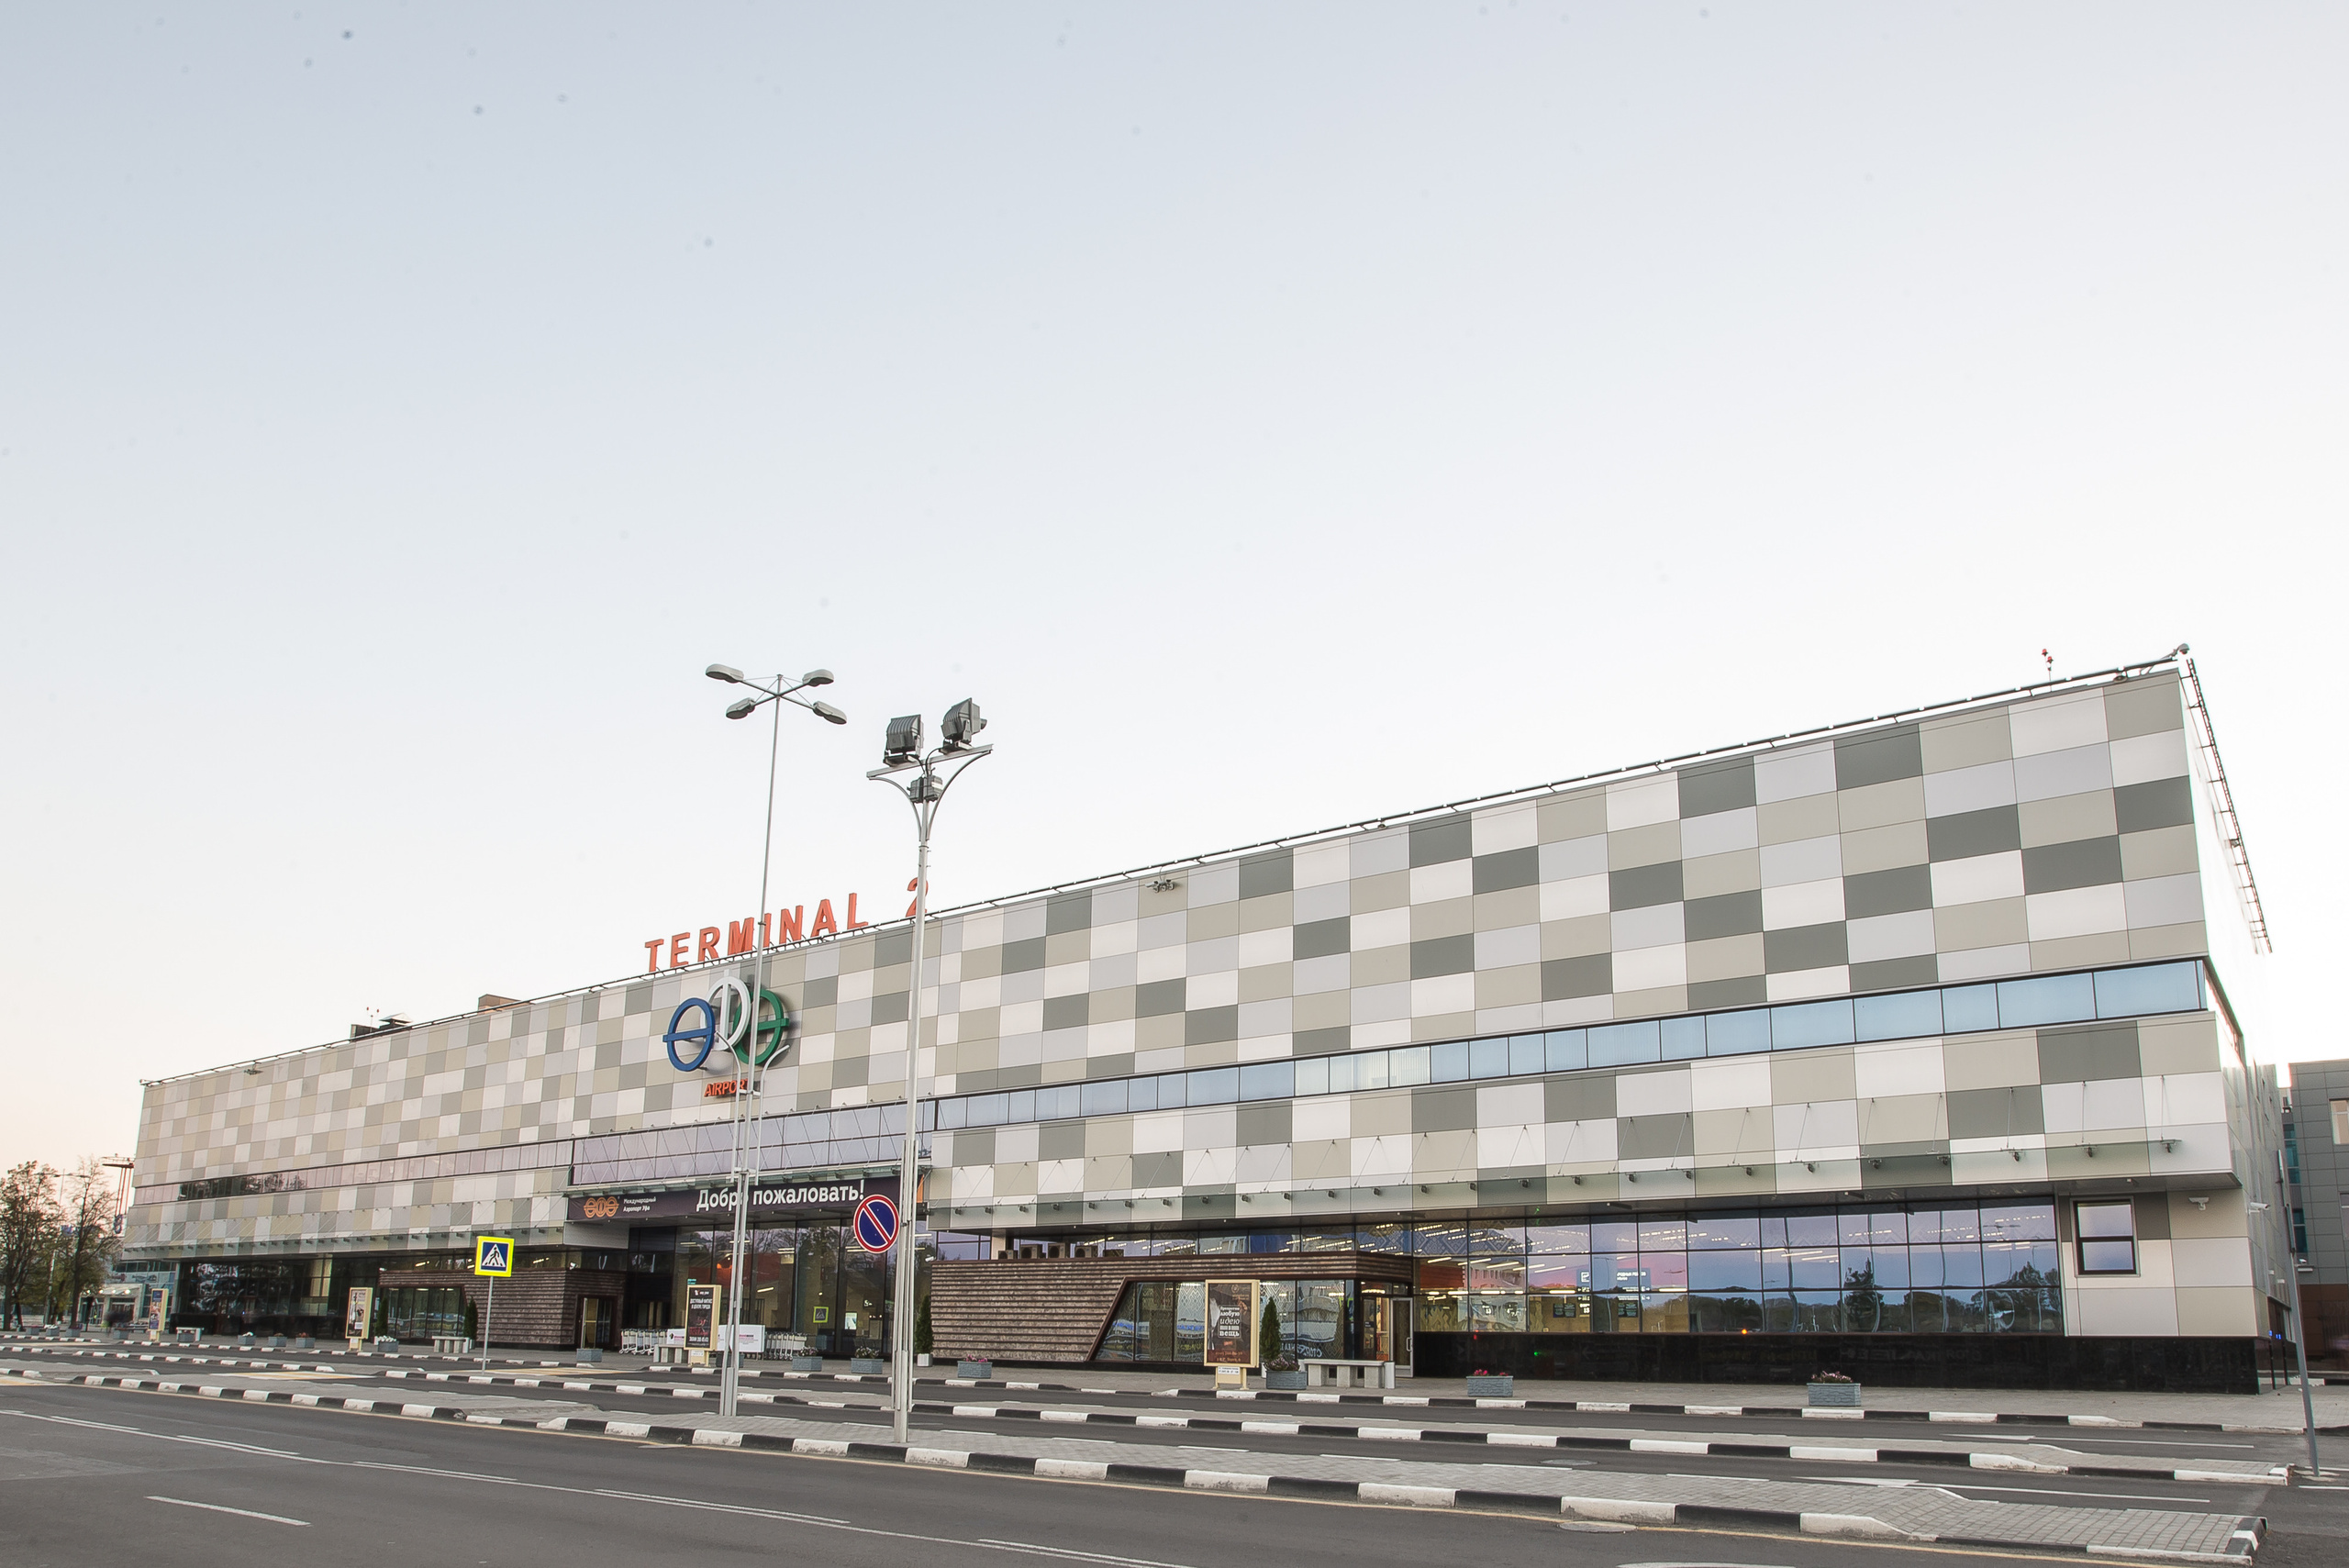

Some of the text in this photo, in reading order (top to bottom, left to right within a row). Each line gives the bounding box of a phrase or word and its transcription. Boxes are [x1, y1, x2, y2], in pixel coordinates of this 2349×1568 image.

[644, 877, 929, 973] TERMINAL 2
[704, 1077, 750, 1097] AIRPOR
[623, 1196, 657, 1205] Международный
[752, 1179, 864, 1206] пожаловать!
[1220, 1317, 1240, 1325] идею
